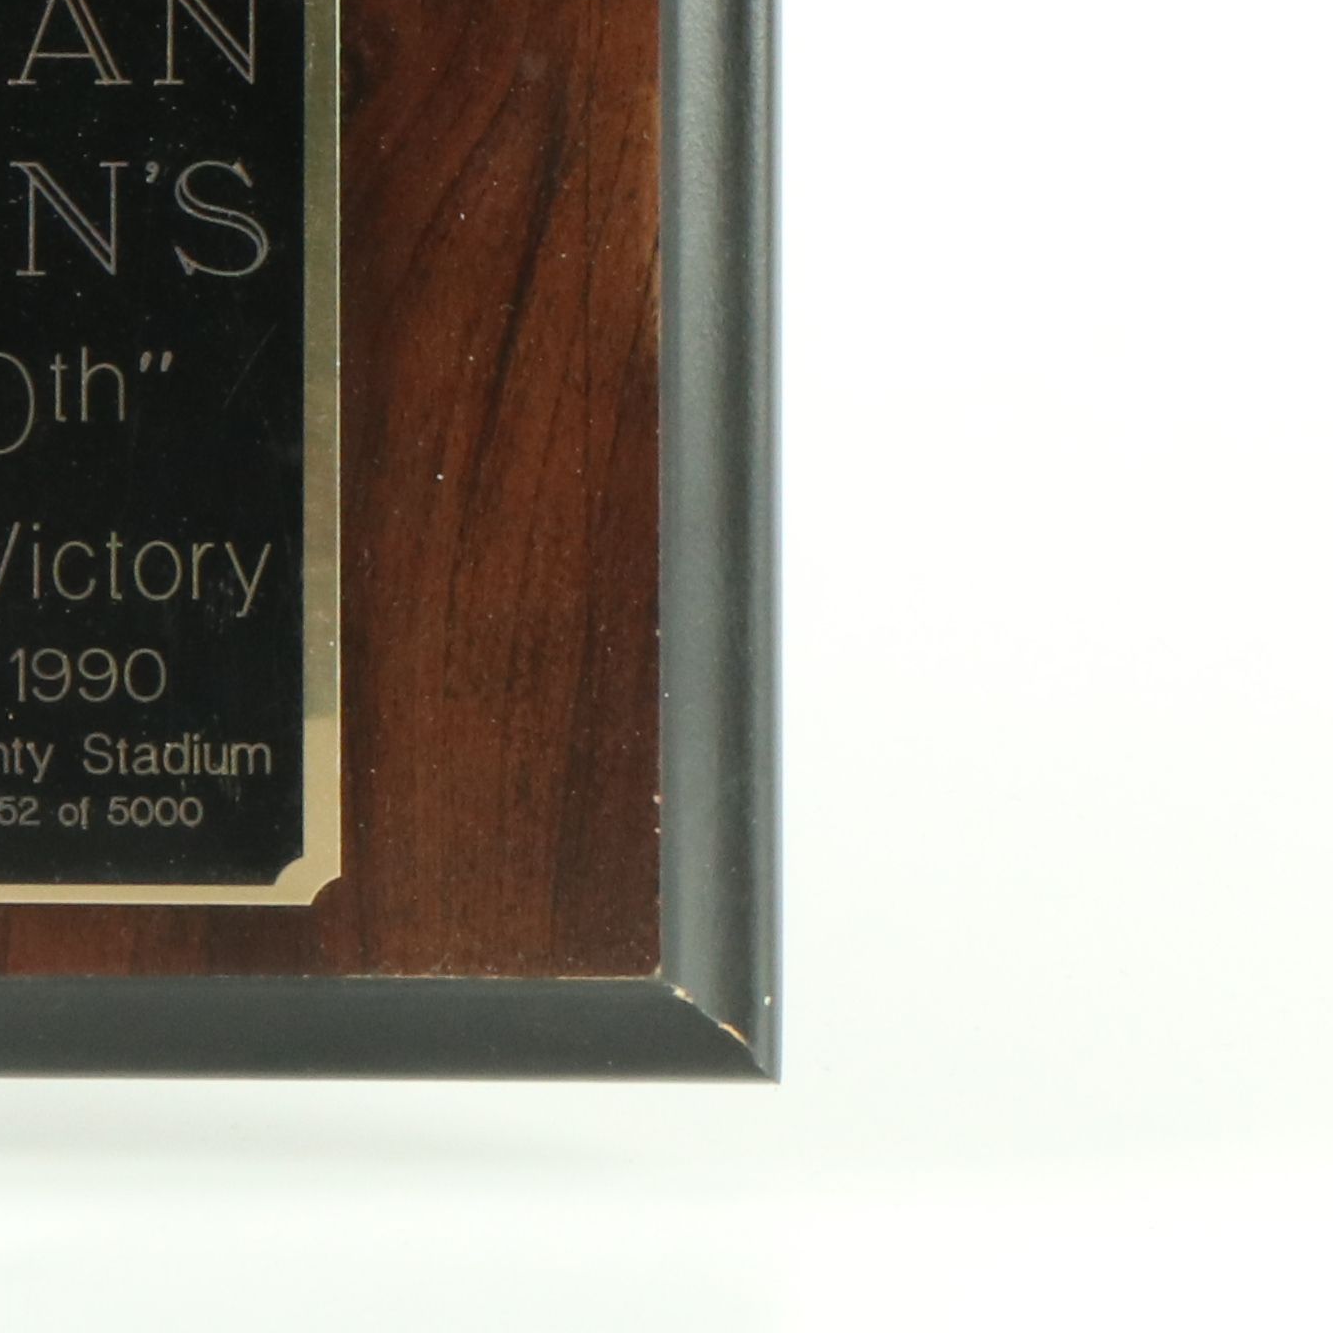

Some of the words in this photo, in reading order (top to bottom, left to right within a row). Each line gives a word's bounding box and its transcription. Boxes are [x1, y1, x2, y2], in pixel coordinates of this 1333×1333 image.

[10, 648, 167, 703] 1990
[83, 734, 273, 776] Stadium
[58, 797, 89, 828] of
[107, 797, 204, 828] 5000
